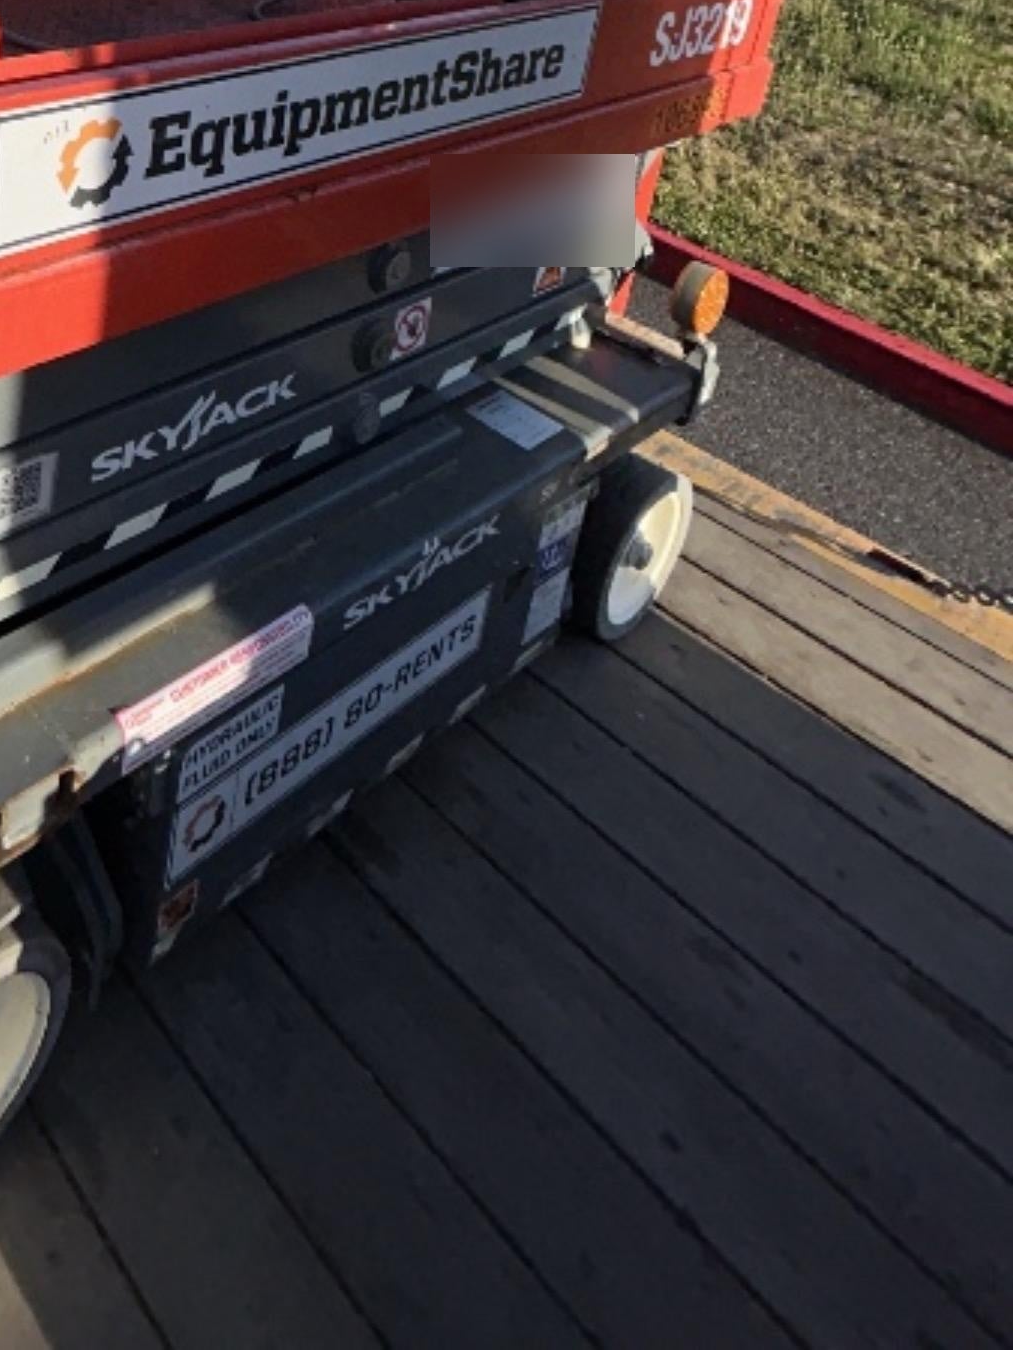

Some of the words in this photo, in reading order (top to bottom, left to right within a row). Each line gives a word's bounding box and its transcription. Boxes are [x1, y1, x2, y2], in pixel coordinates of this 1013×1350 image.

[142, 39, 565, 179] EquipmentShare
[91, 374, 296, 484] SKYJACK
[342, 515, 500, 630] SKYJACK
[343, 614, 477, 728] 80-RENTS
[185, 694, 280, 765] HYDRAULIC
[236, 716, 277, 756] ONLY
